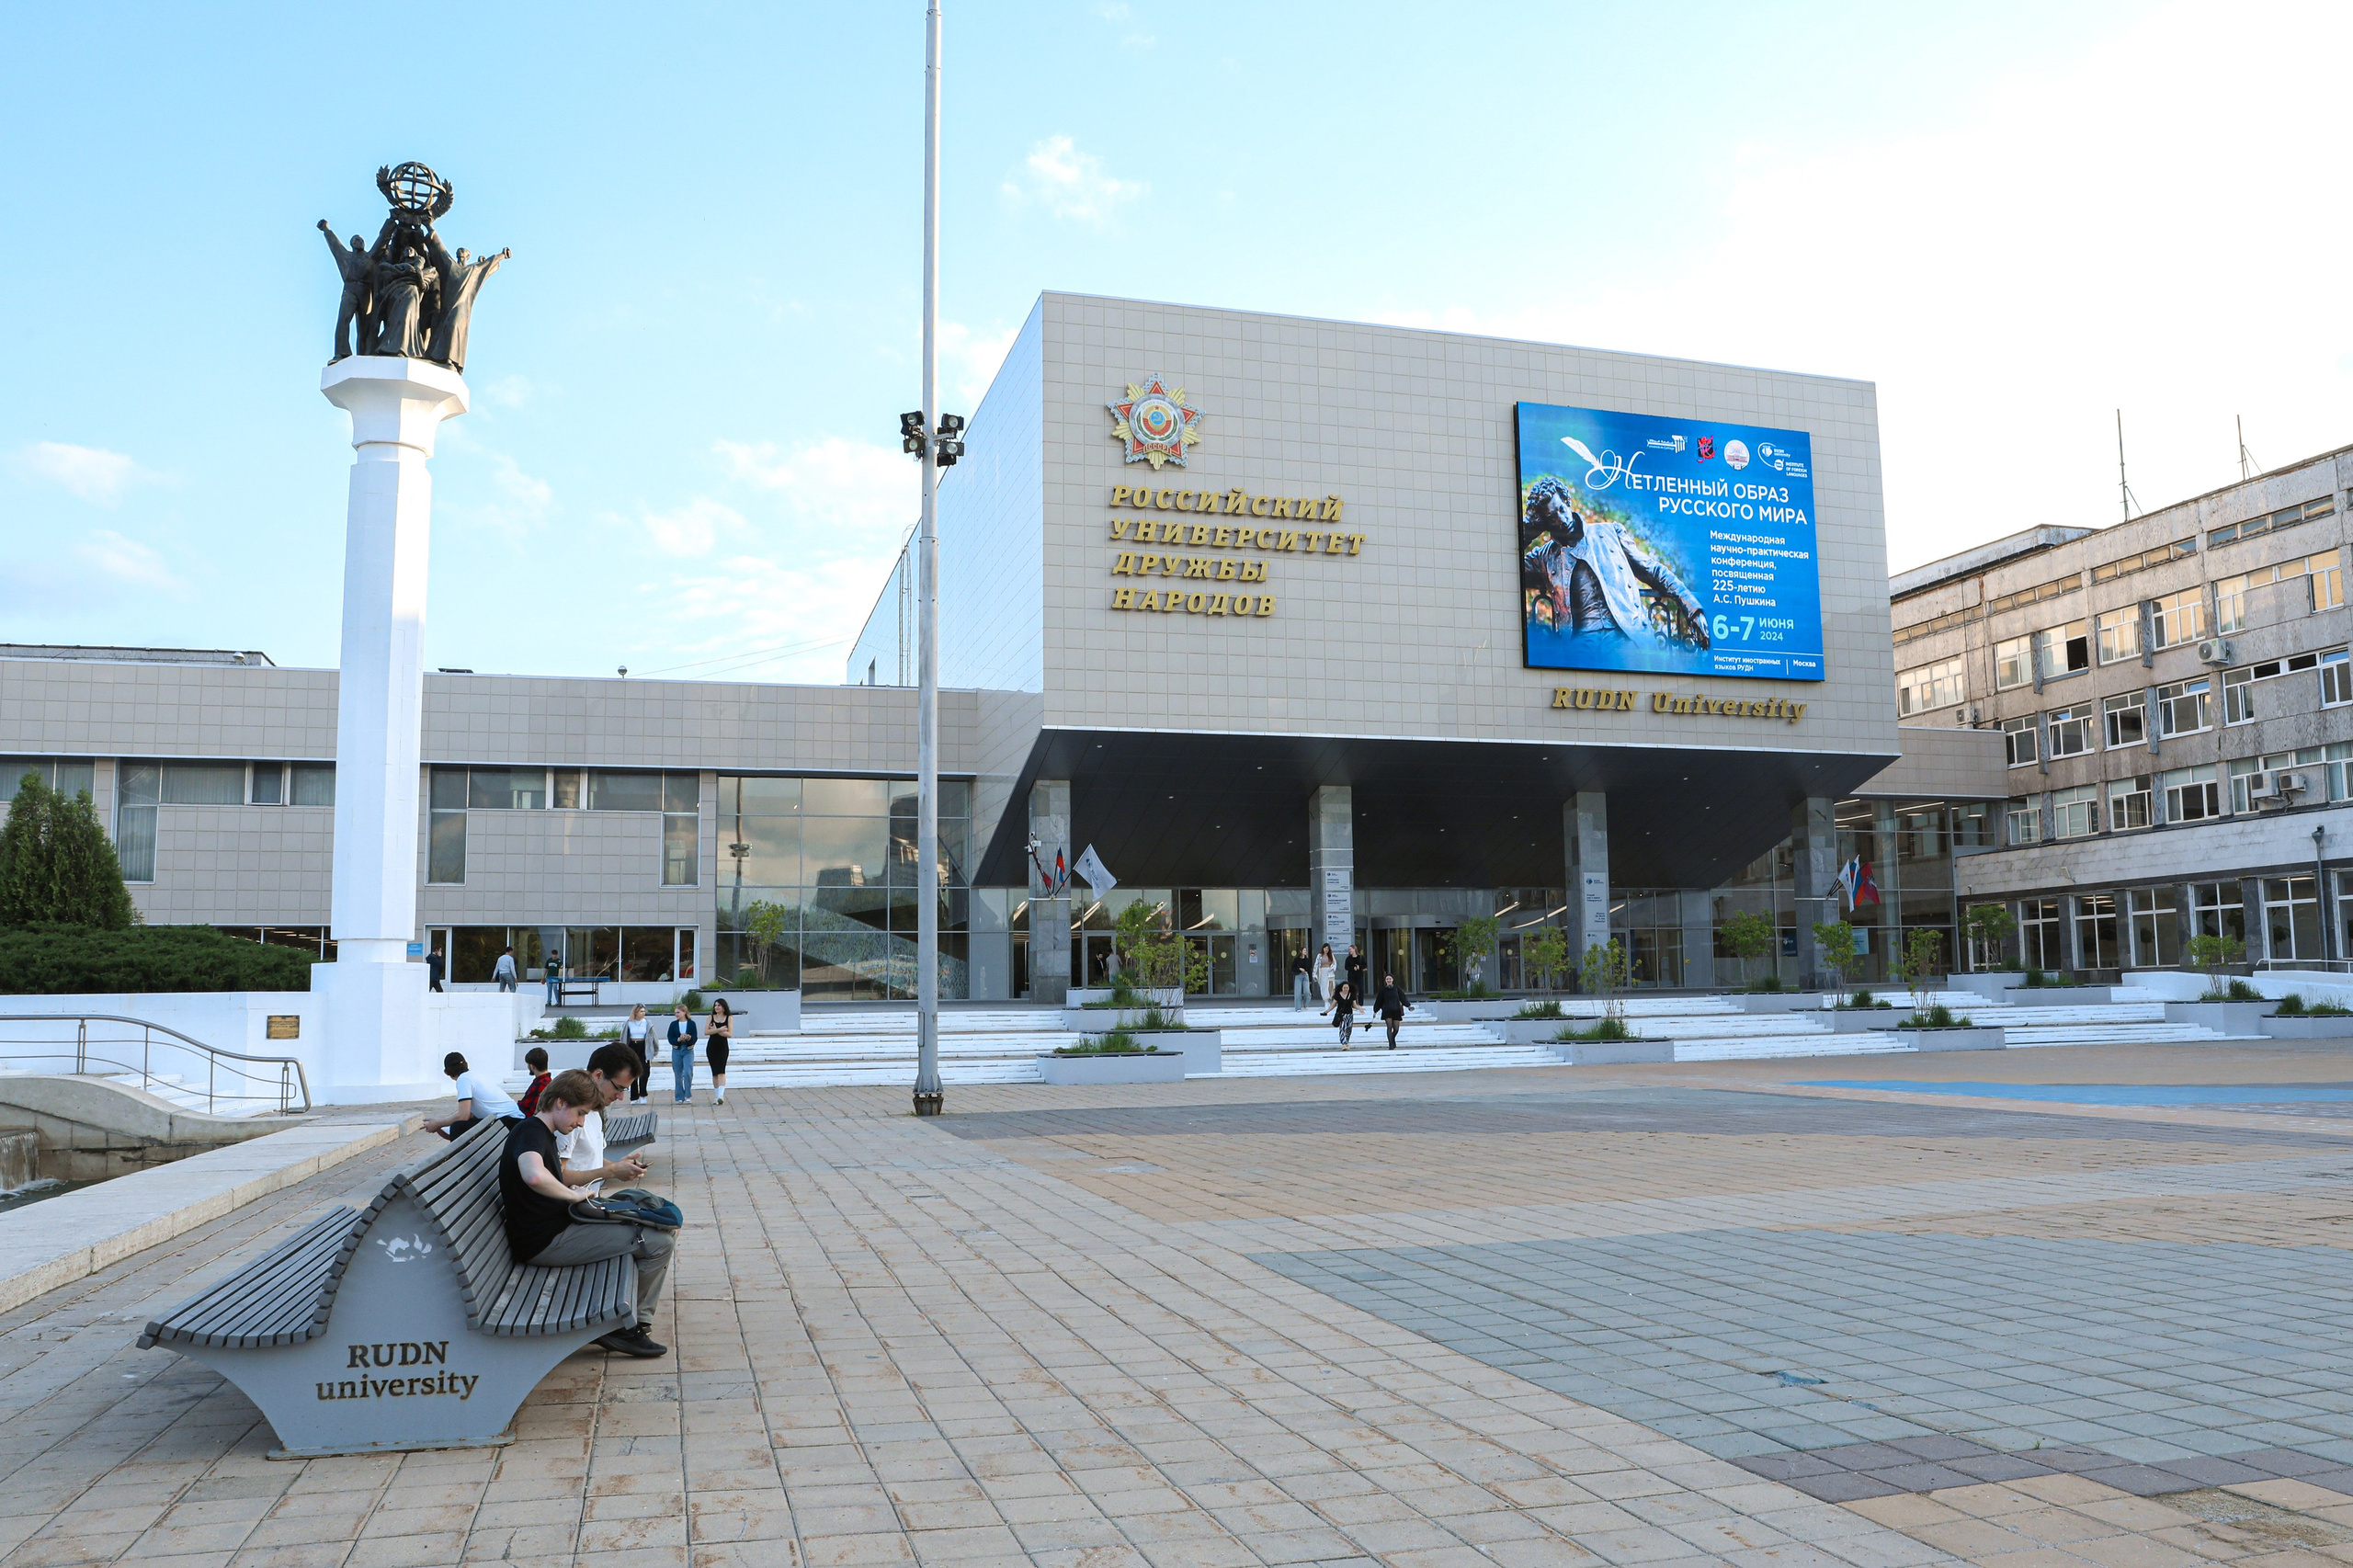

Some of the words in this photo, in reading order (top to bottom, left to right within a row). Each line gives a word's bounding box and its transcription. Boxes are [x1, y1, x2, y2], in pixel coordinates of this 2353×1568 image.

[1733, 483, 1790, 504] ОБРАЗ
[1109, 484, 1346, 522] РОССИЙСКИЙ
[1659, 496, 1754, 520] РУССКОГО
[1759, 506, 1808, 525] МИРА
[1109, 517, 1367, 555] УНИВЕРСИТЕТ
[1710, 529, 1786, 545] Международная
[1711, 544, 1809, 560] научно-практическая
[1111, 551, 1271, 582] ДРУЖБЫ
[1711, 556, 1777, 570] конференция,
[1711, 568, 1775, 581] посвященная
[1712, 579, 1767, 594] 225-летию
[1111, 586, 1277, 616] НАРОДОВ
[1713, 593, 1733, 604] А.С.
[1734, 595, 1777, 607] Пушкина
[1712, 614, 1755, 641] 6-7
[1760, 631, 1784, 641] 2024
[1713, 654, 1742, 663] Институт
[1742, 657, 1781, 665] иностранных
[1736, 664, 1754, 672] РУДН
[1792, 659, 1816, 667] Москва
[1552, 687, 1639, 710] RUDN
[1653, 692, 1807, 722] University
[347, 1341, 449, 1369] RUDN
[315, 1369, 480, 1401] university
